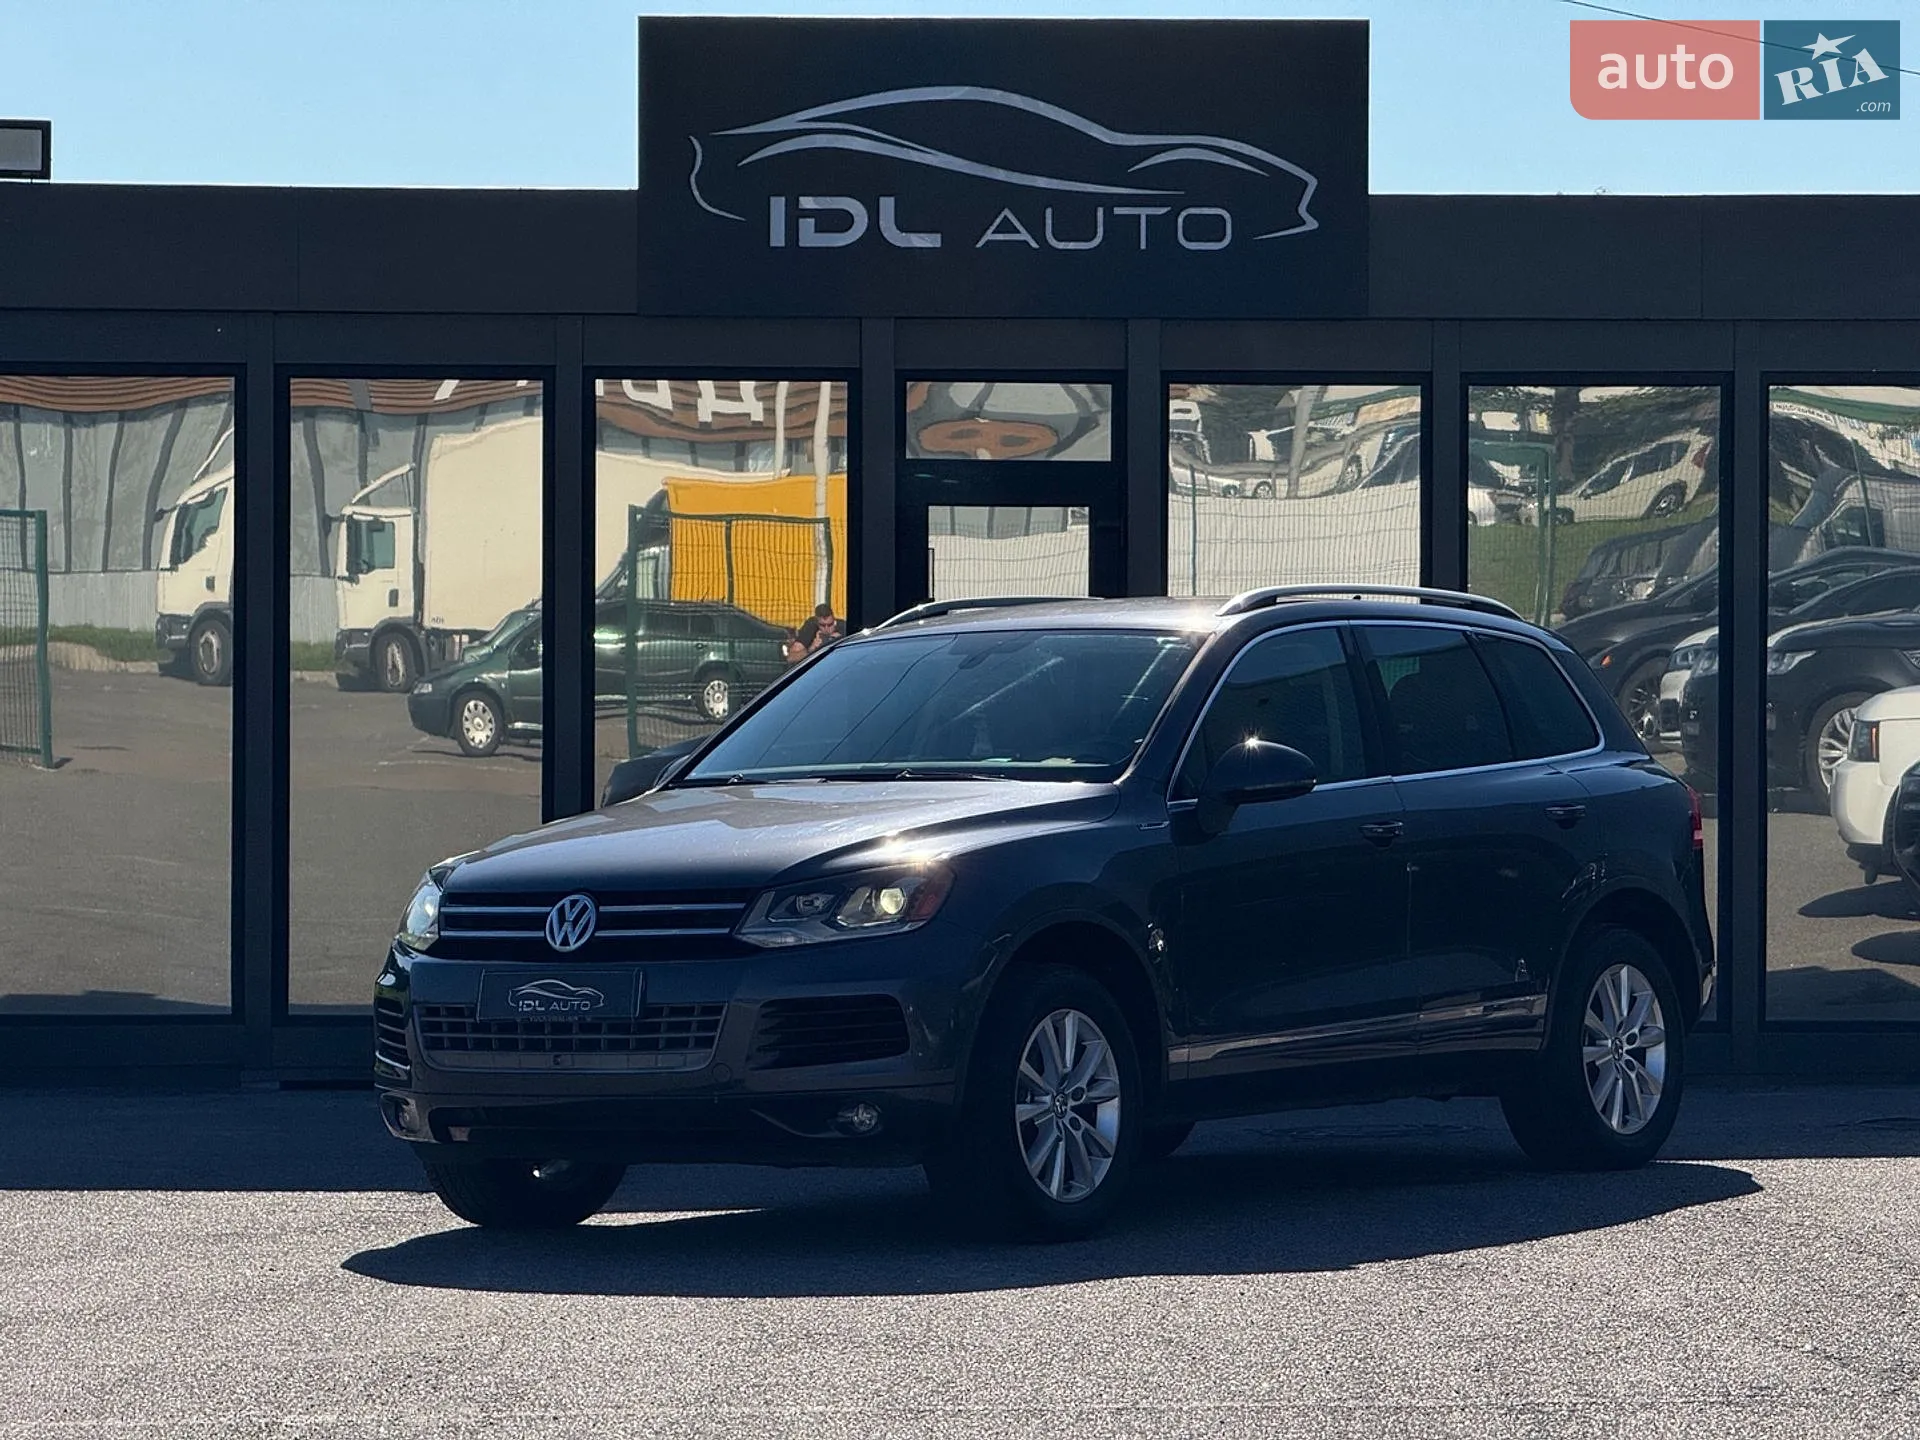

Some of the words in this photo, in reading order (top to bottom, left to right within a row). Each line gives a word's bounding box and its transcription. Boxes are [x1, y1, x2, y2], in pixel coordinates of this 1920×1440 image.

[769, 196, 942, 248] IDL
[975, 206, 1232, 251] AUTO
[518, 1000, 545, 1011] IDL
[549, 1001, 591, 1011] AUTO
